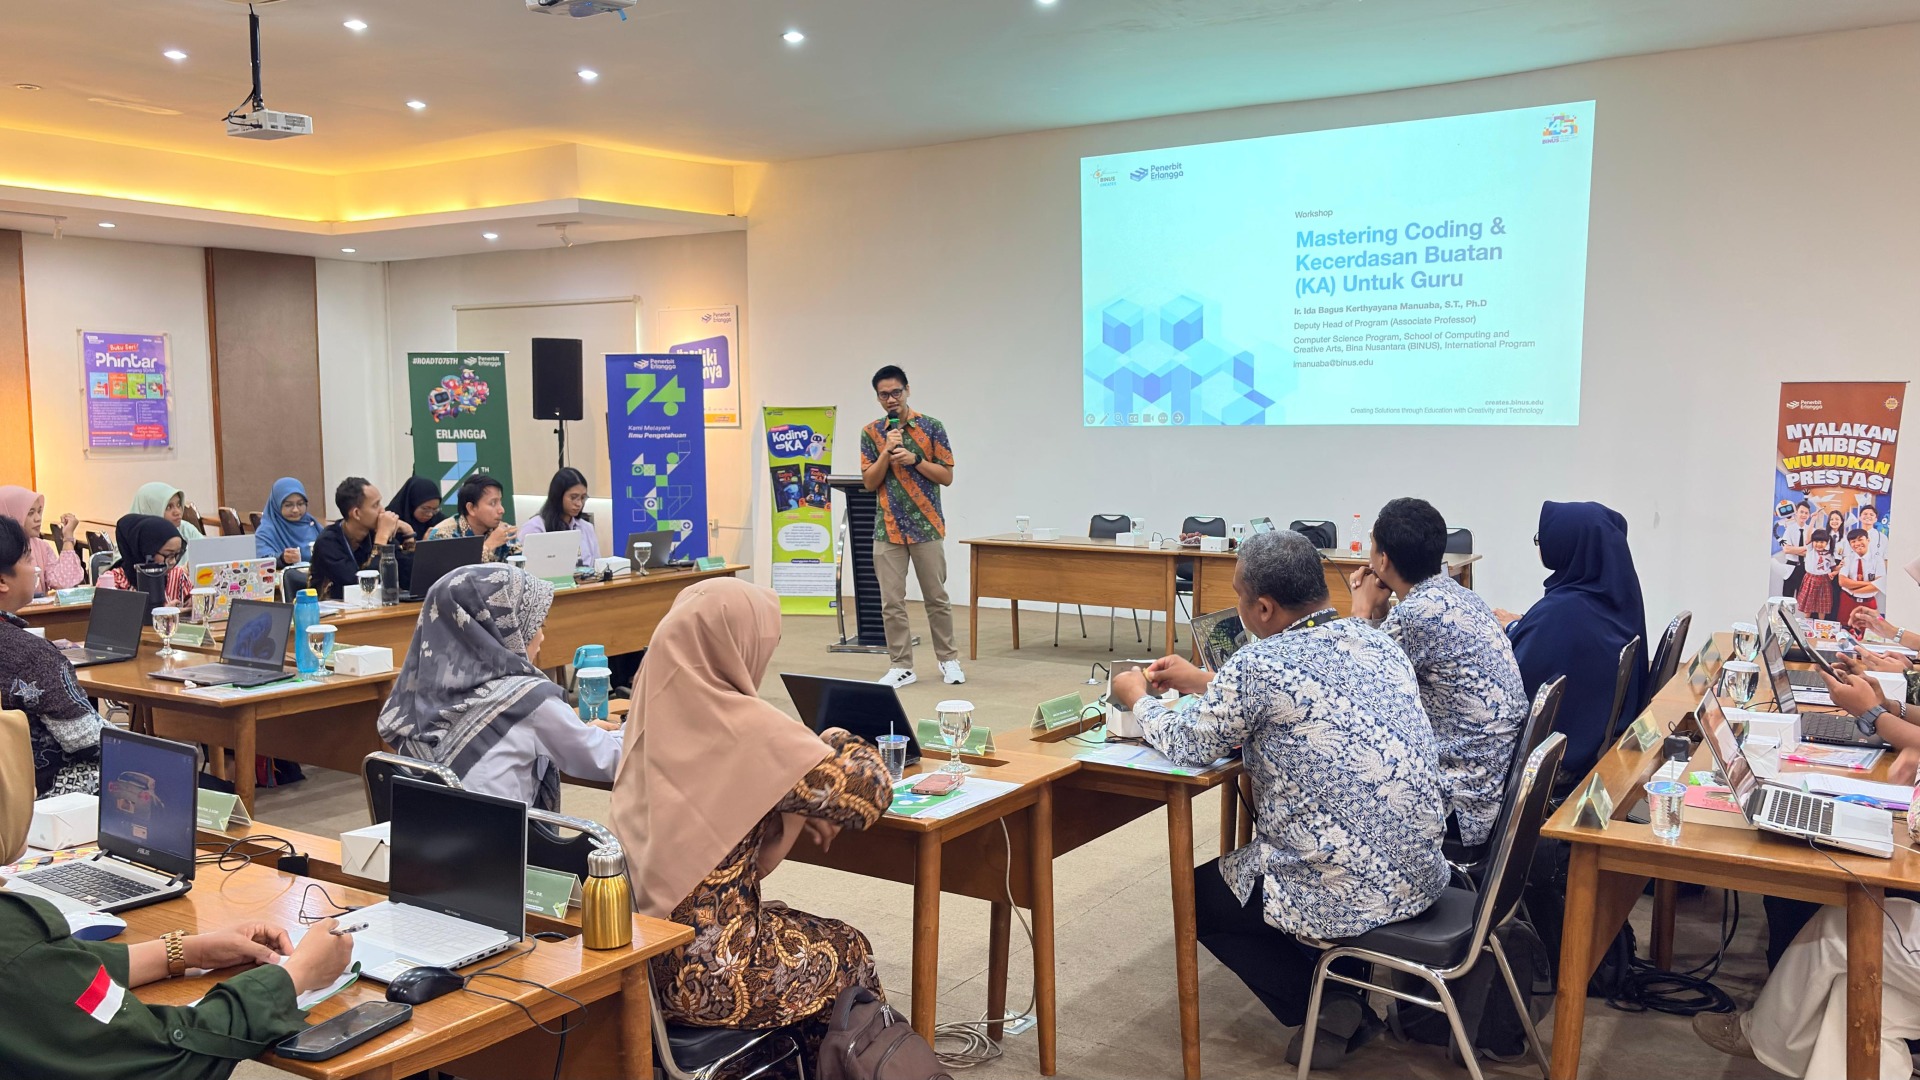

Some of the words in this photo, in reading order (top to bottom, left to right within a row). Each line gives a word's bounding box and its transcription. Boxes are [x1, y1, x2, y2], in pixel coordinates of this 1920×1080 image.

[1151, 162, 1182, 172] Penerbit
[1151, 171, 1183, 180] Erlangga
[1295, 209, 1333, 218] Workshop
[1296, 226, 1398, 248] Mastering
[1405, 220, 1483, 240] Coding
[1490, 217, 1506, 235] &
[1296, 250, 1417, 271] Kecerdasan
[1425, 244, 1502, 263] Buatan
[1295, 276, 1336, 298] (KA)
[1343, 272, 1404, 292] Untuk
[1411, 271, 1463, 288] Guru
[1318, 306, 1344, 315] Bagus
[1345, 304, 1398, 312] Kerthyayana
[1399, 302, 1442, 310] Manuaba,
[1444, 300, 1463, 309] S.T.,
[1294, 321, 1320, 331] Deputy
[1322, 320, 1343, 329] Head
[1354, 319, 1388, 328] Program
[1390, 317, 1432, 327] (Associate
[1434, 315, 1476, 325] Professor)
[1293, 336, 1331, 346] Computer
[1332, 335, 1364, 343] Science
[1365, 333, 1402, 343] Program,
[1403, 332, 1432, 340] School
[1444, 331, 1491, 341] Computing
[1493, 330, 1510, 338] and
[1293, 346, 1324, 354] Creative
[1325, 345, 1344, 353] Arts,
[1345, 344, 1363, 352] Bina
[1365, 343, 1406, 351] Nusantara
[1407, 341, 1442, 351] (BINUS),
[1444, 341, 1497, 349] International
[1499, 339, 1535, 349] Program
[95, 352, 157, 369] Phintar
[412, 357, 459, 365] #ROADTO75TH
[626, 373, 686, 416] 74
[1350, 407, 1374, 415] Creating
[1467, 407, 1495, 415] Creativity
[1509, 407, 1544, 415] Technology
[436, 429, 487, 440] ERLANGGA
[772, 430, 808, 442] Koding
[1786, 422, 1897, 443] NYALAKAN
[784, 440, 804, 451] KA
[1798, 437, 1881, 458] AMBISI
[1782, 454, 1891, 476] WUJUDKAN
[1785, 469, 1891, 493] PRESTASI
